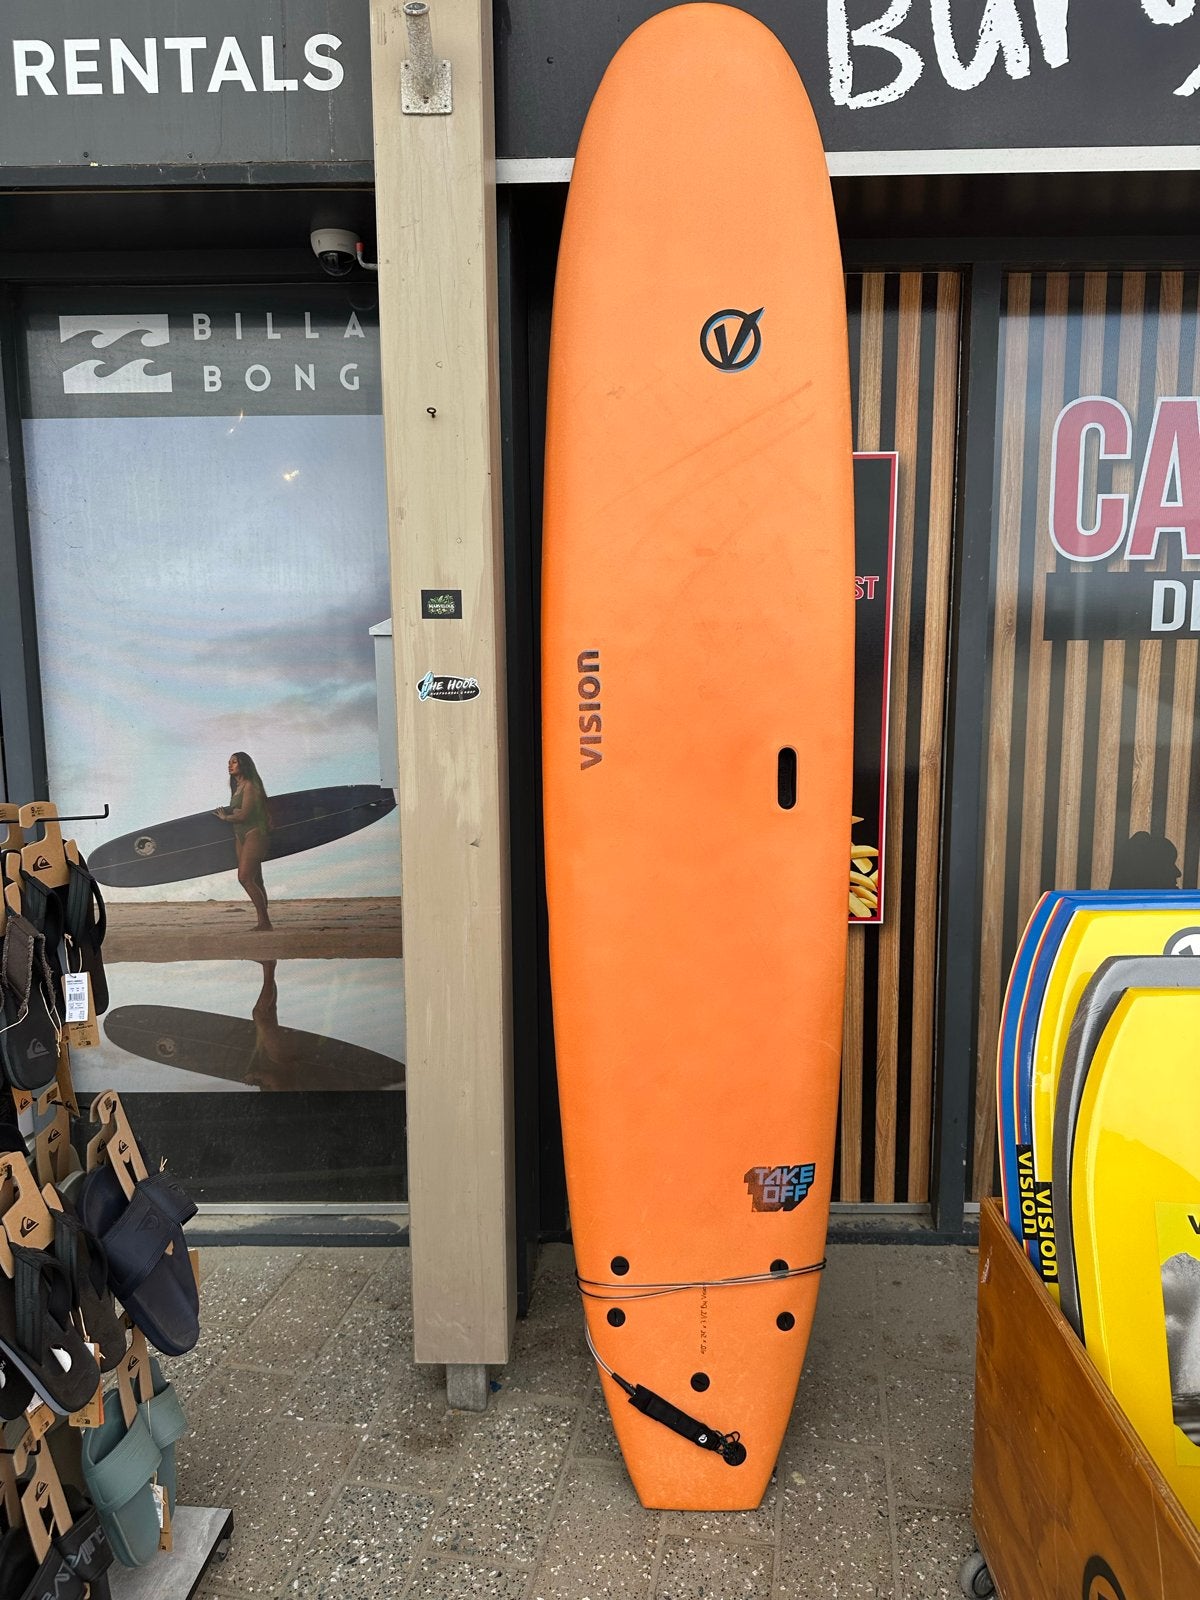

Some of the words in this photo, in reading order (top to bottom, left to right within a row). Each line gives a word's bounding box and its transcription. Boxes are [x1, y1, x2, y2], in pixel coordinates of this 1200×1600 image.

[12, 33, 345, 97] RENTALS
[192, 311, 366, 341] BILLA
[203, 363, 361, 392] BONG
[1048, 395, 1200, 562] CA
[754, 1165, 814, 1186] TAKE
[762, 1184, 807, 1203] OFF
